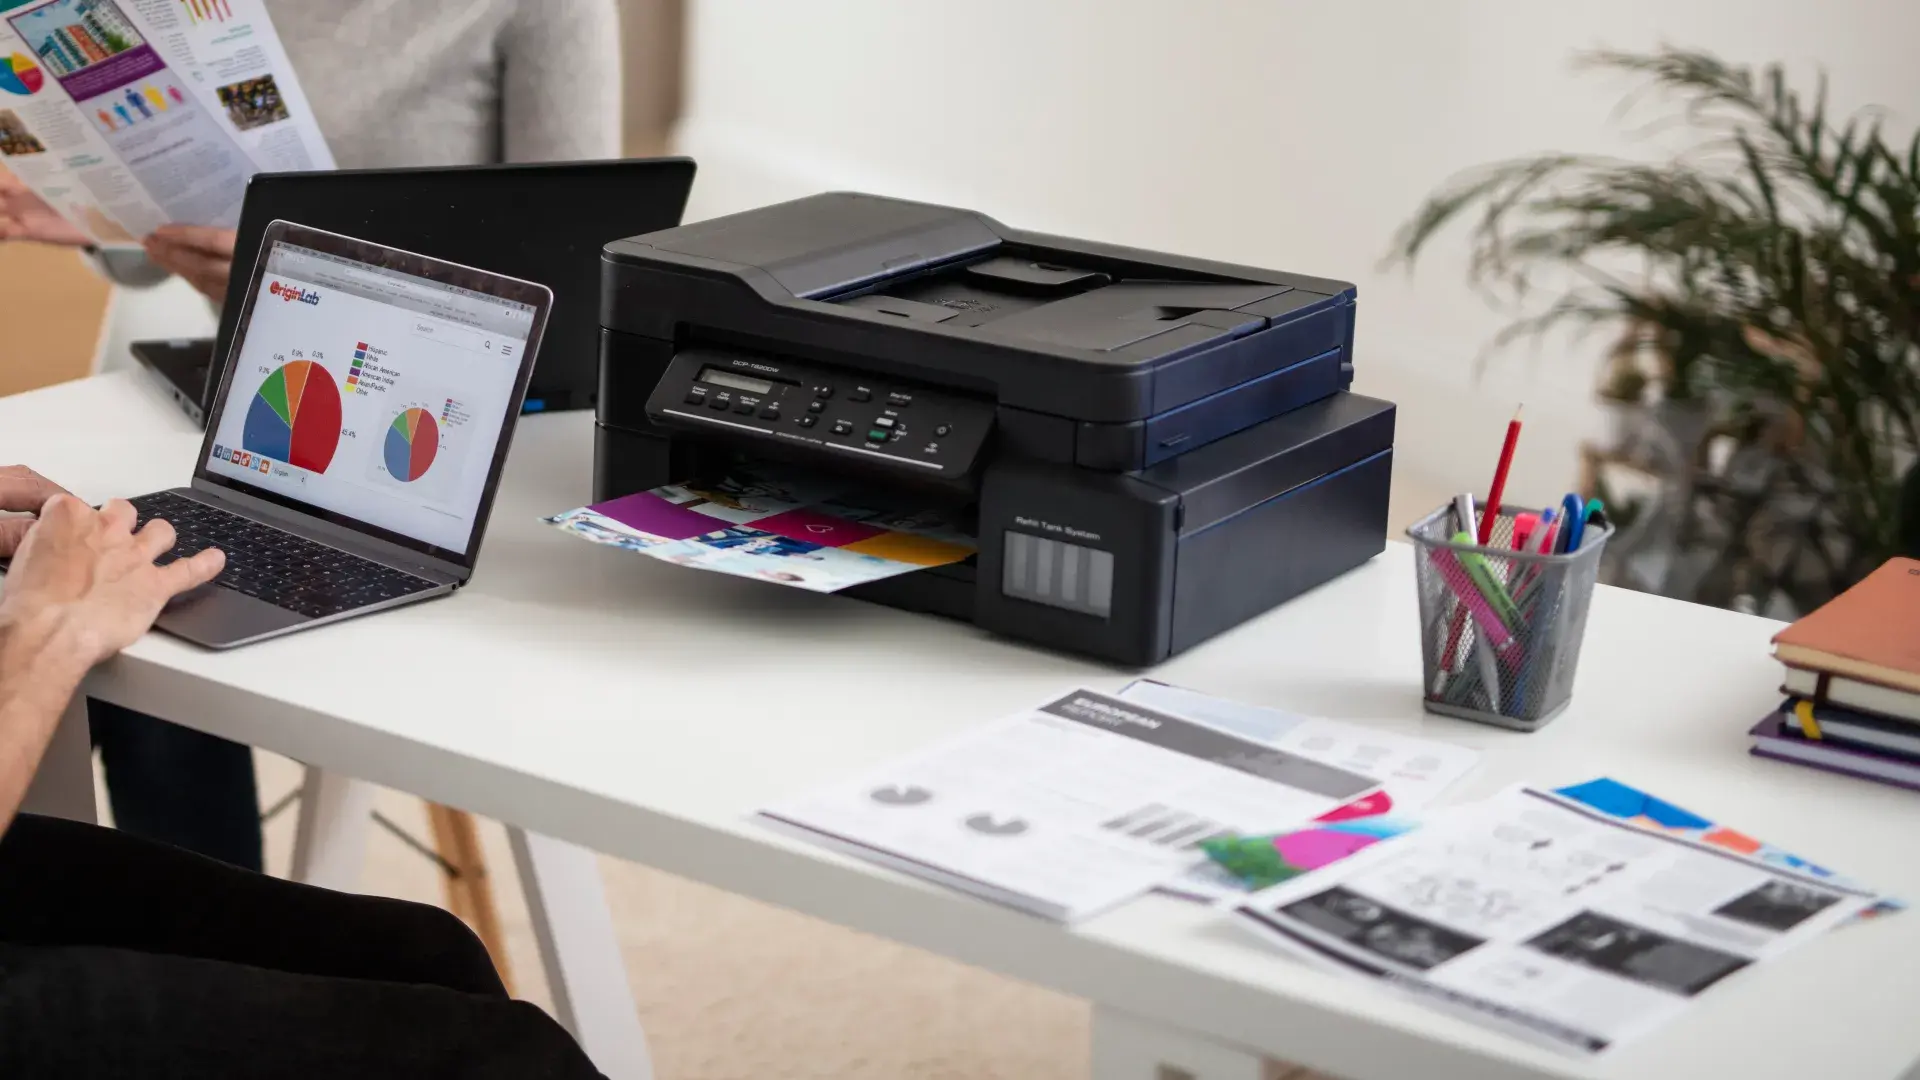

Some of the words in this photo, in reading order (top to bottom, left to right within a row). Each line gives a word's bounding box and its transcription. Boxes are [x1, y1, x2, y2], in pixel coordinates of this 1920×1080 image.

[269, 281, 320, 306] OriginLab
[368, 346, 388, 356] Hispanic
[366, 353, 379, 363] White
[379, 366, 401, 377] American
[1041, 521, 1063, 532] Tank
[1064, 526, 1101, 541] System
